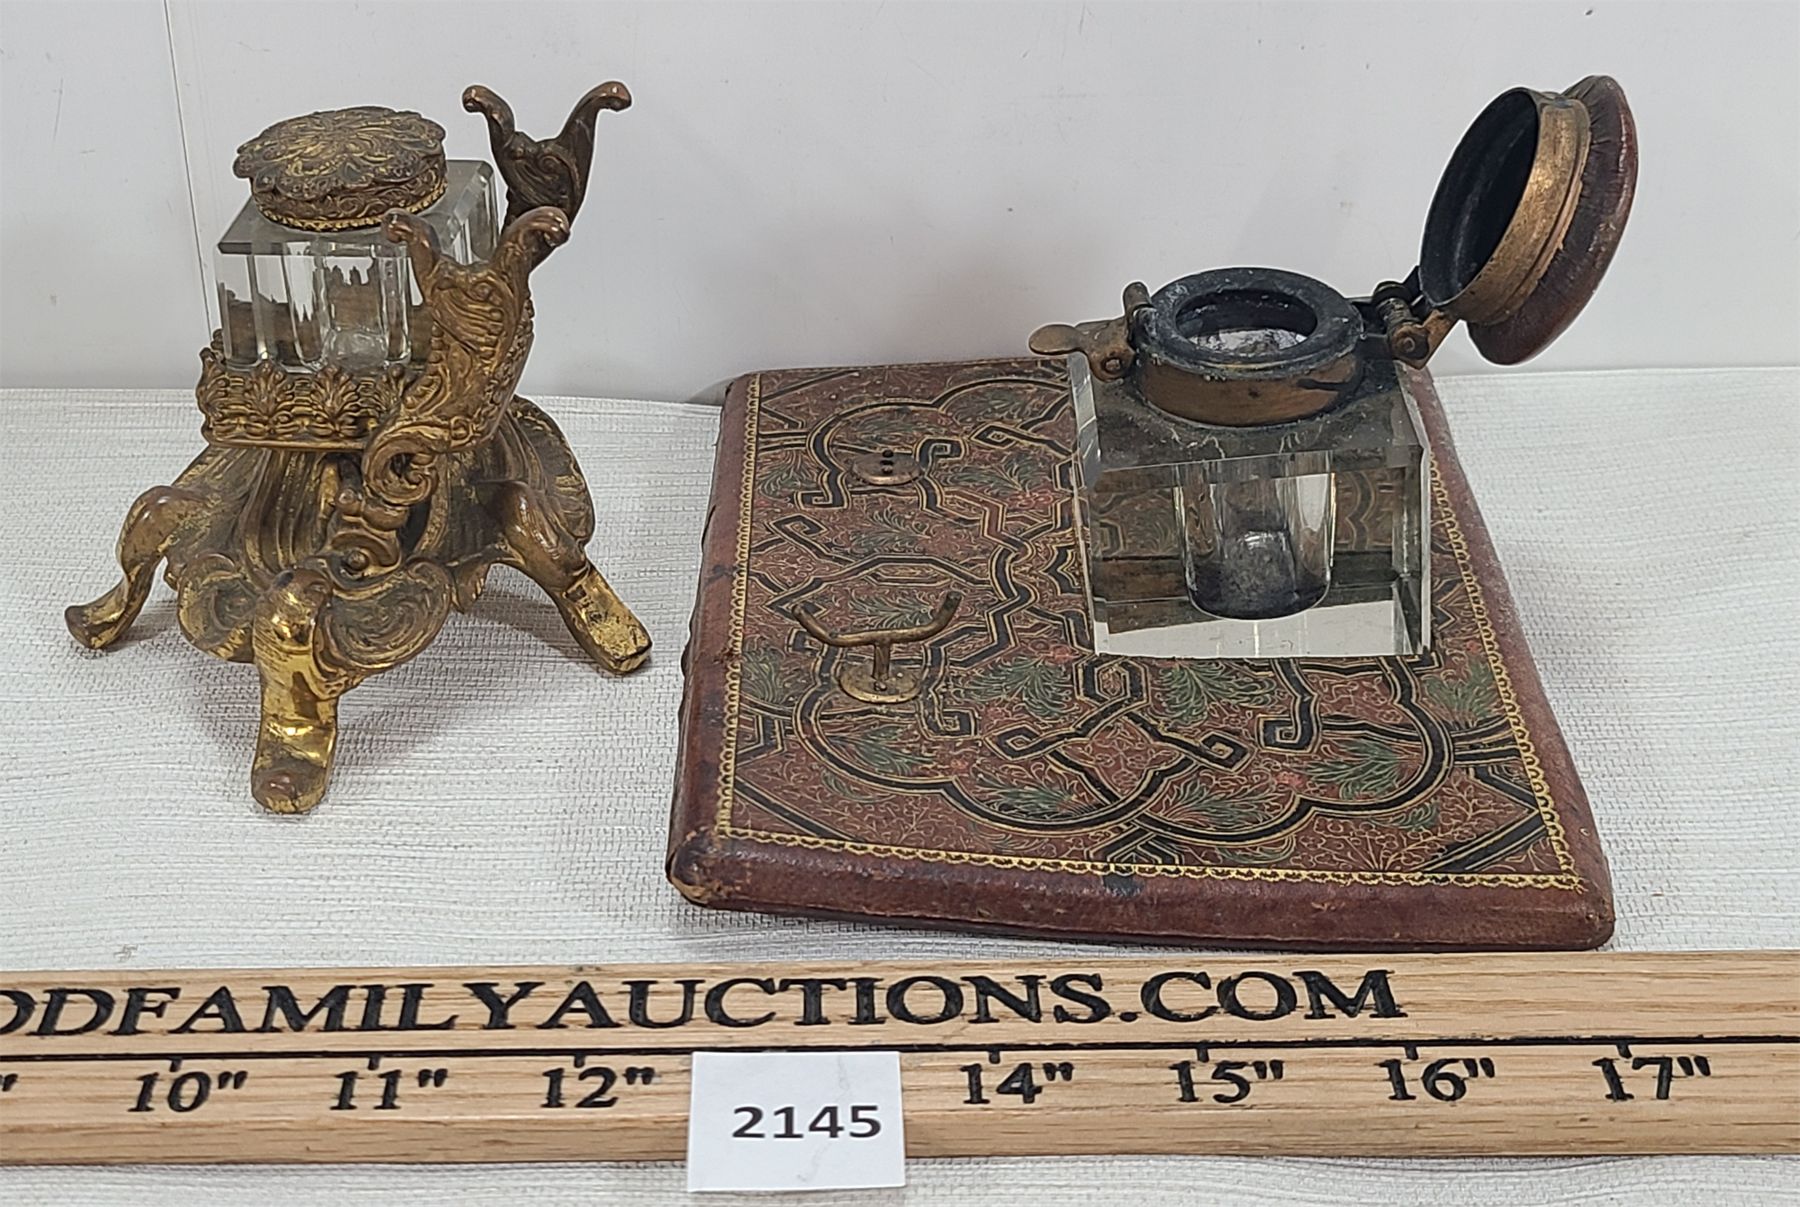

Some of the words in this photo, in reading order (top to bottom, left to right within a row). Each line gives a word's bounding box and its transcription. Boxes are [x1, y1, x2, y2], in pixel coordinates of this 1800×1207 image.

[127, 1070, 248, 1113] 10"
[331, 1068, 449, 1111] 11"
[541, 1066, 656, 1109] 12"
[958, 1062, 1075, 1105] 14"
[1168, 1059, 1285, 1104] 15"
[1374, 1057, 1496, 1102] 16"
[1592, 1054, 1712, 1102] 17"
[733, 1105, 881, 1139] 2145
